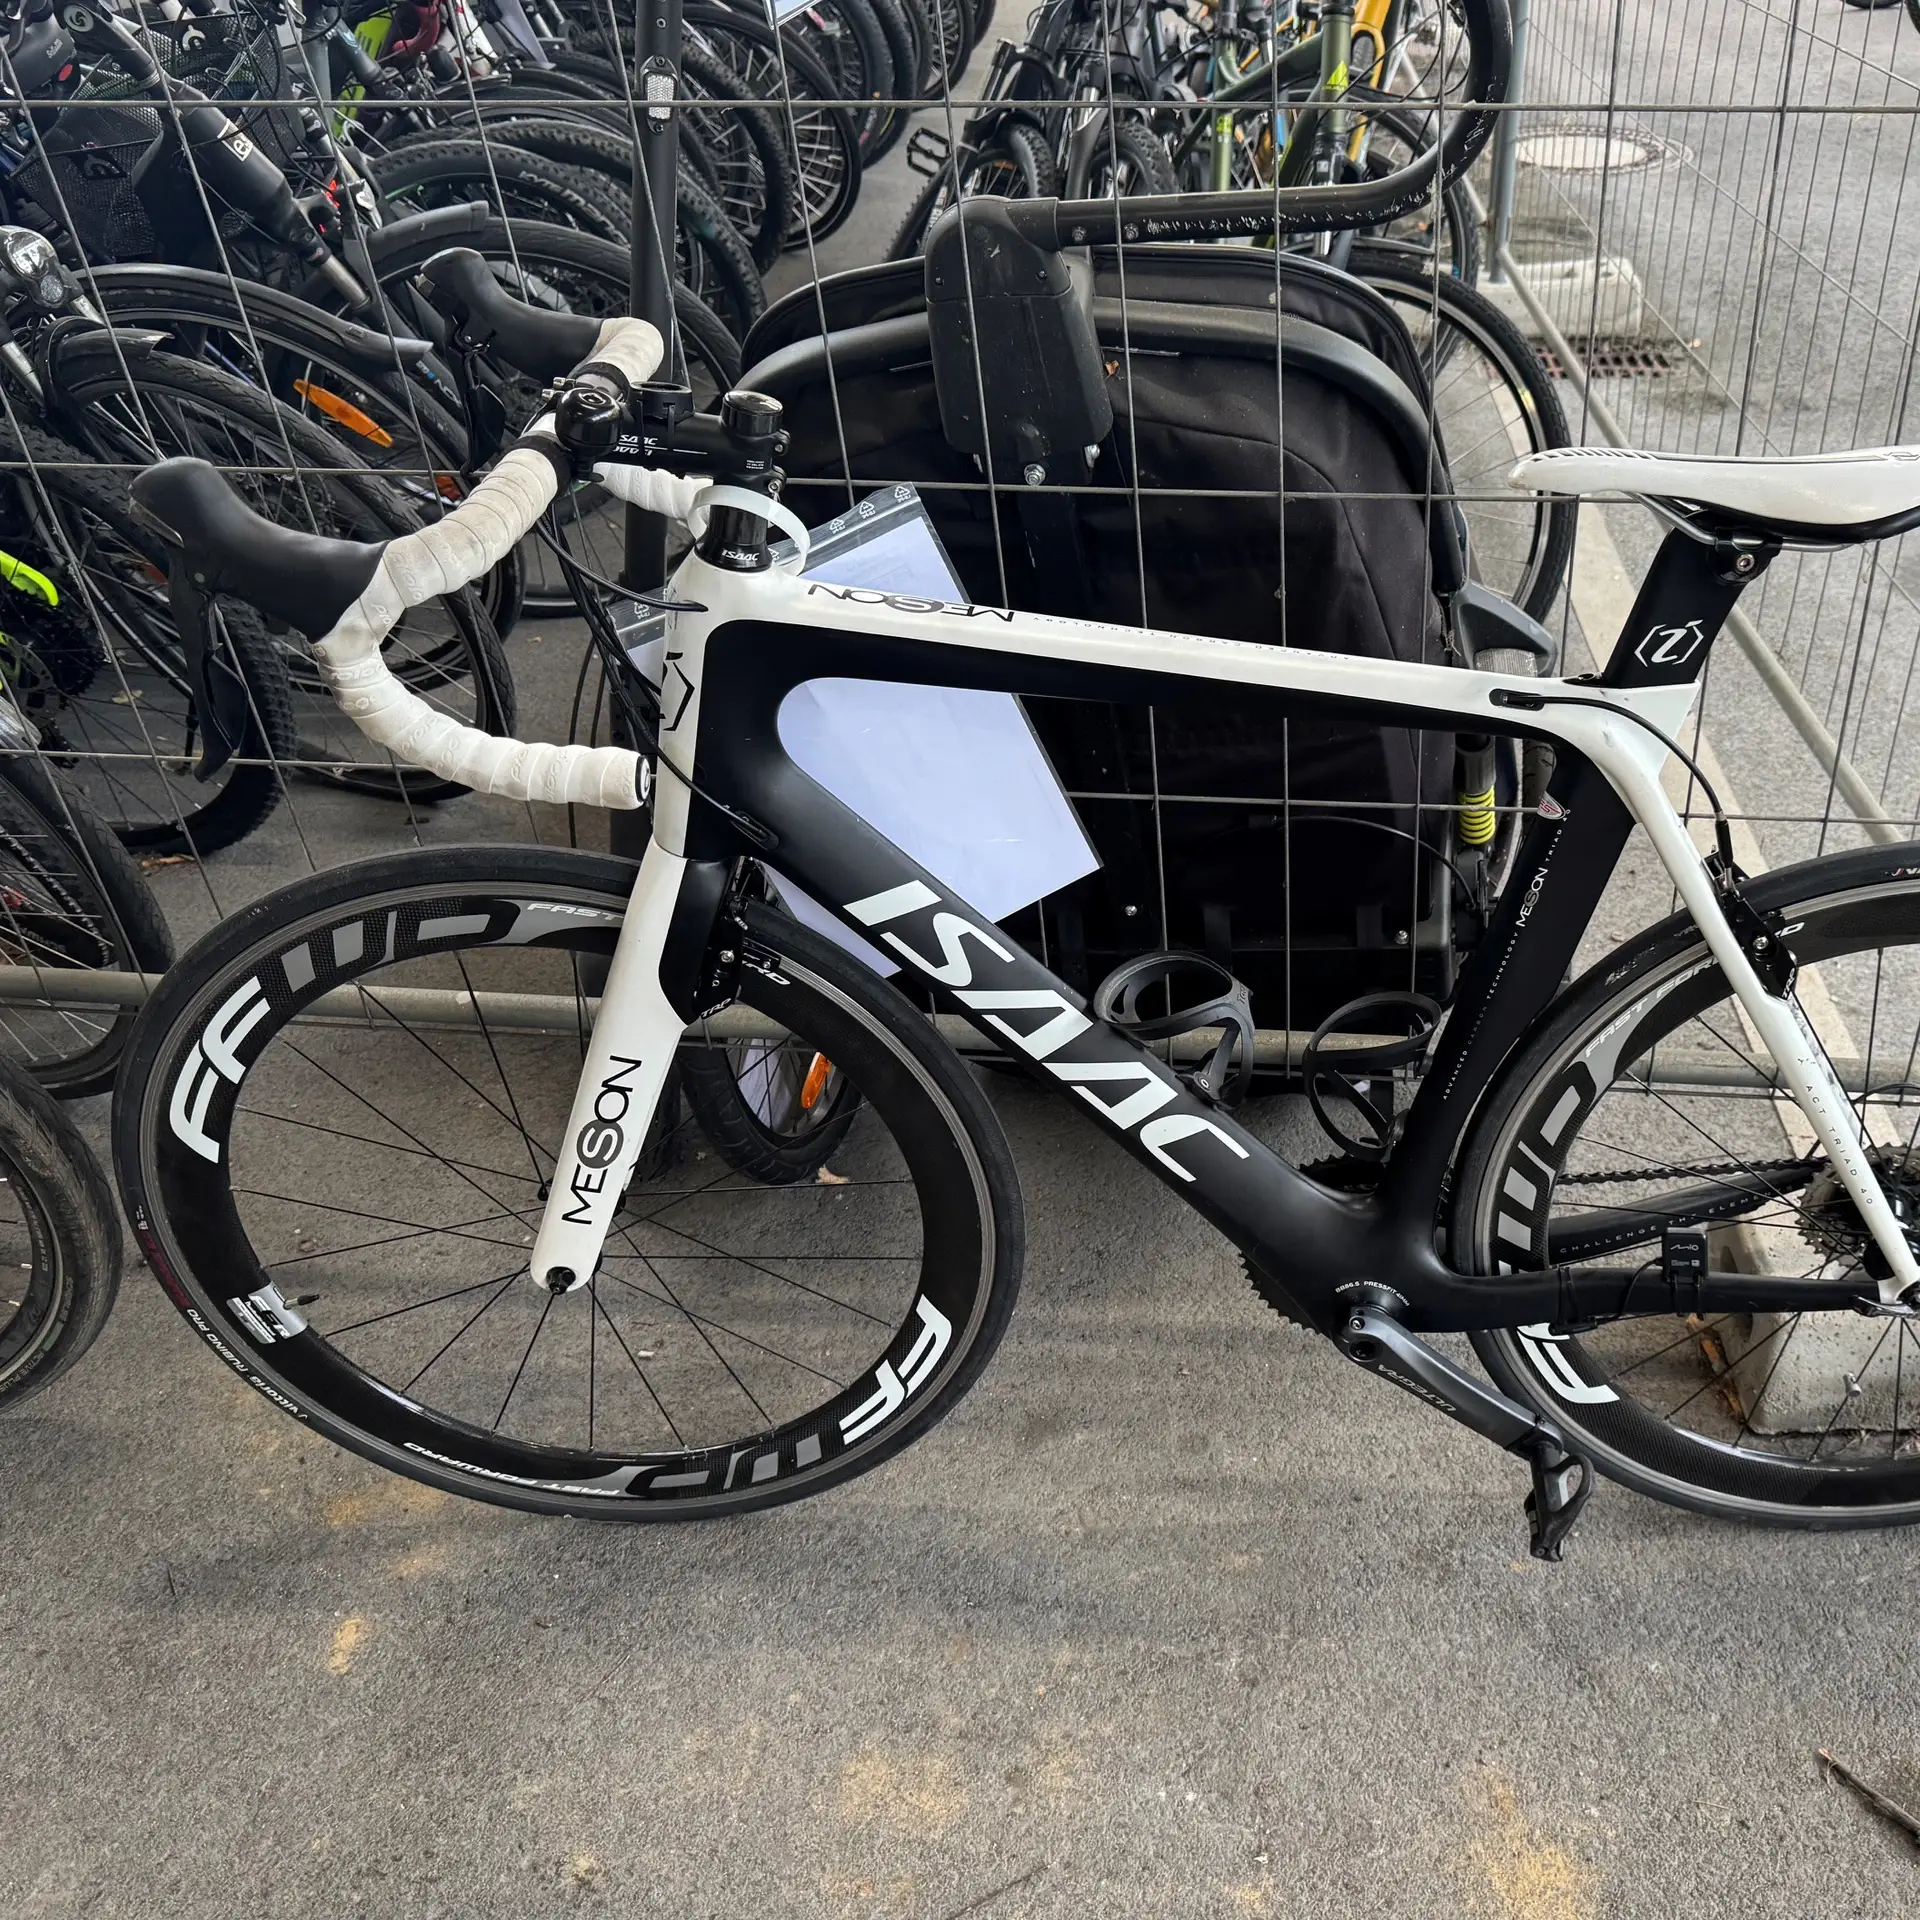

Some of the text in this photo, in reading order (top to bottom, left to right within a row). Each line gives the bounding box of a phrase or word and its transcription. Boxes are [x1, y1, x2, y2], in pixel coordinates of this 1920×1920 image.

[721, 548, 760, 562] ISAAC
[808, 583, 1015, 623] MESON
[526, 903, 624, 921] FAST
[1442, 1049, 1469, 1101] ADVANCED
[1485, 931, 1519, 1000] TECHNOLOGY
[1515, 867, 1549, 928] MESON
[701, 997, 732, 1019] TRP
[1584, 997, 1650, 1059] FAST
[842, 879, 1250, 1183] ISAAC
[561, 1054, 643, 1225] MESON
[1805, 1084, 1873, 1205] ACT TRIAD 40
[1559, 1225, 1657, 1254] CHALLENGE
[1363, 1280, 1397, 1294] PRESSFIT
[186, 1308, 210, 1333] PRO
[206, 1333, 249, 1373] RUBINO
[1377, 1363, 1457, 1412] ULTEGRA
[403, 1441, 621, 1497] FAST FORWARD
